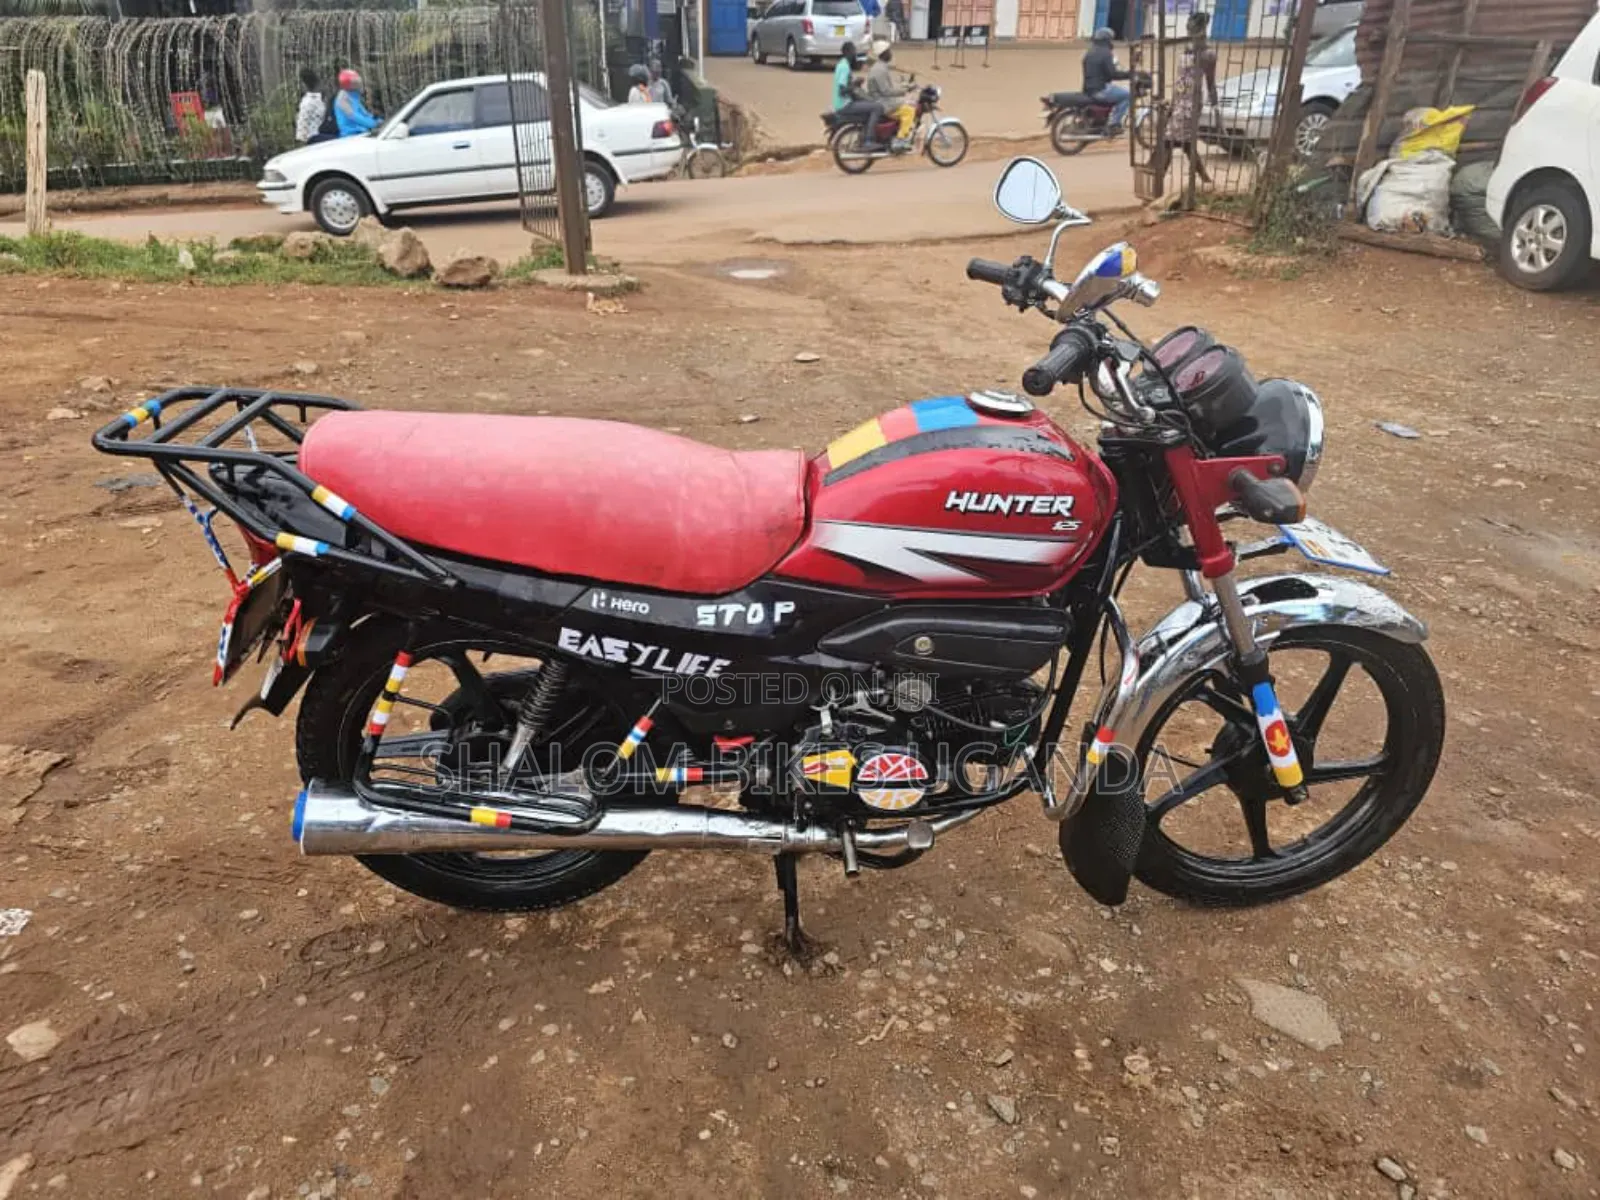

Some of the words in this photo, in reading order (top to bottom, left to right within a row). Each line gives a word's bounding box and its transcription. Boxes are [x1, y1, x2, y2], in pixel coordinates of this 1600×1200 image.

[945, 491, 1074, 517] HUNTER
[610, 597, 650, 615] Hero
[696, 601, 796, 627] STOP
[557, 626, 733, 678] EASYLIFE
